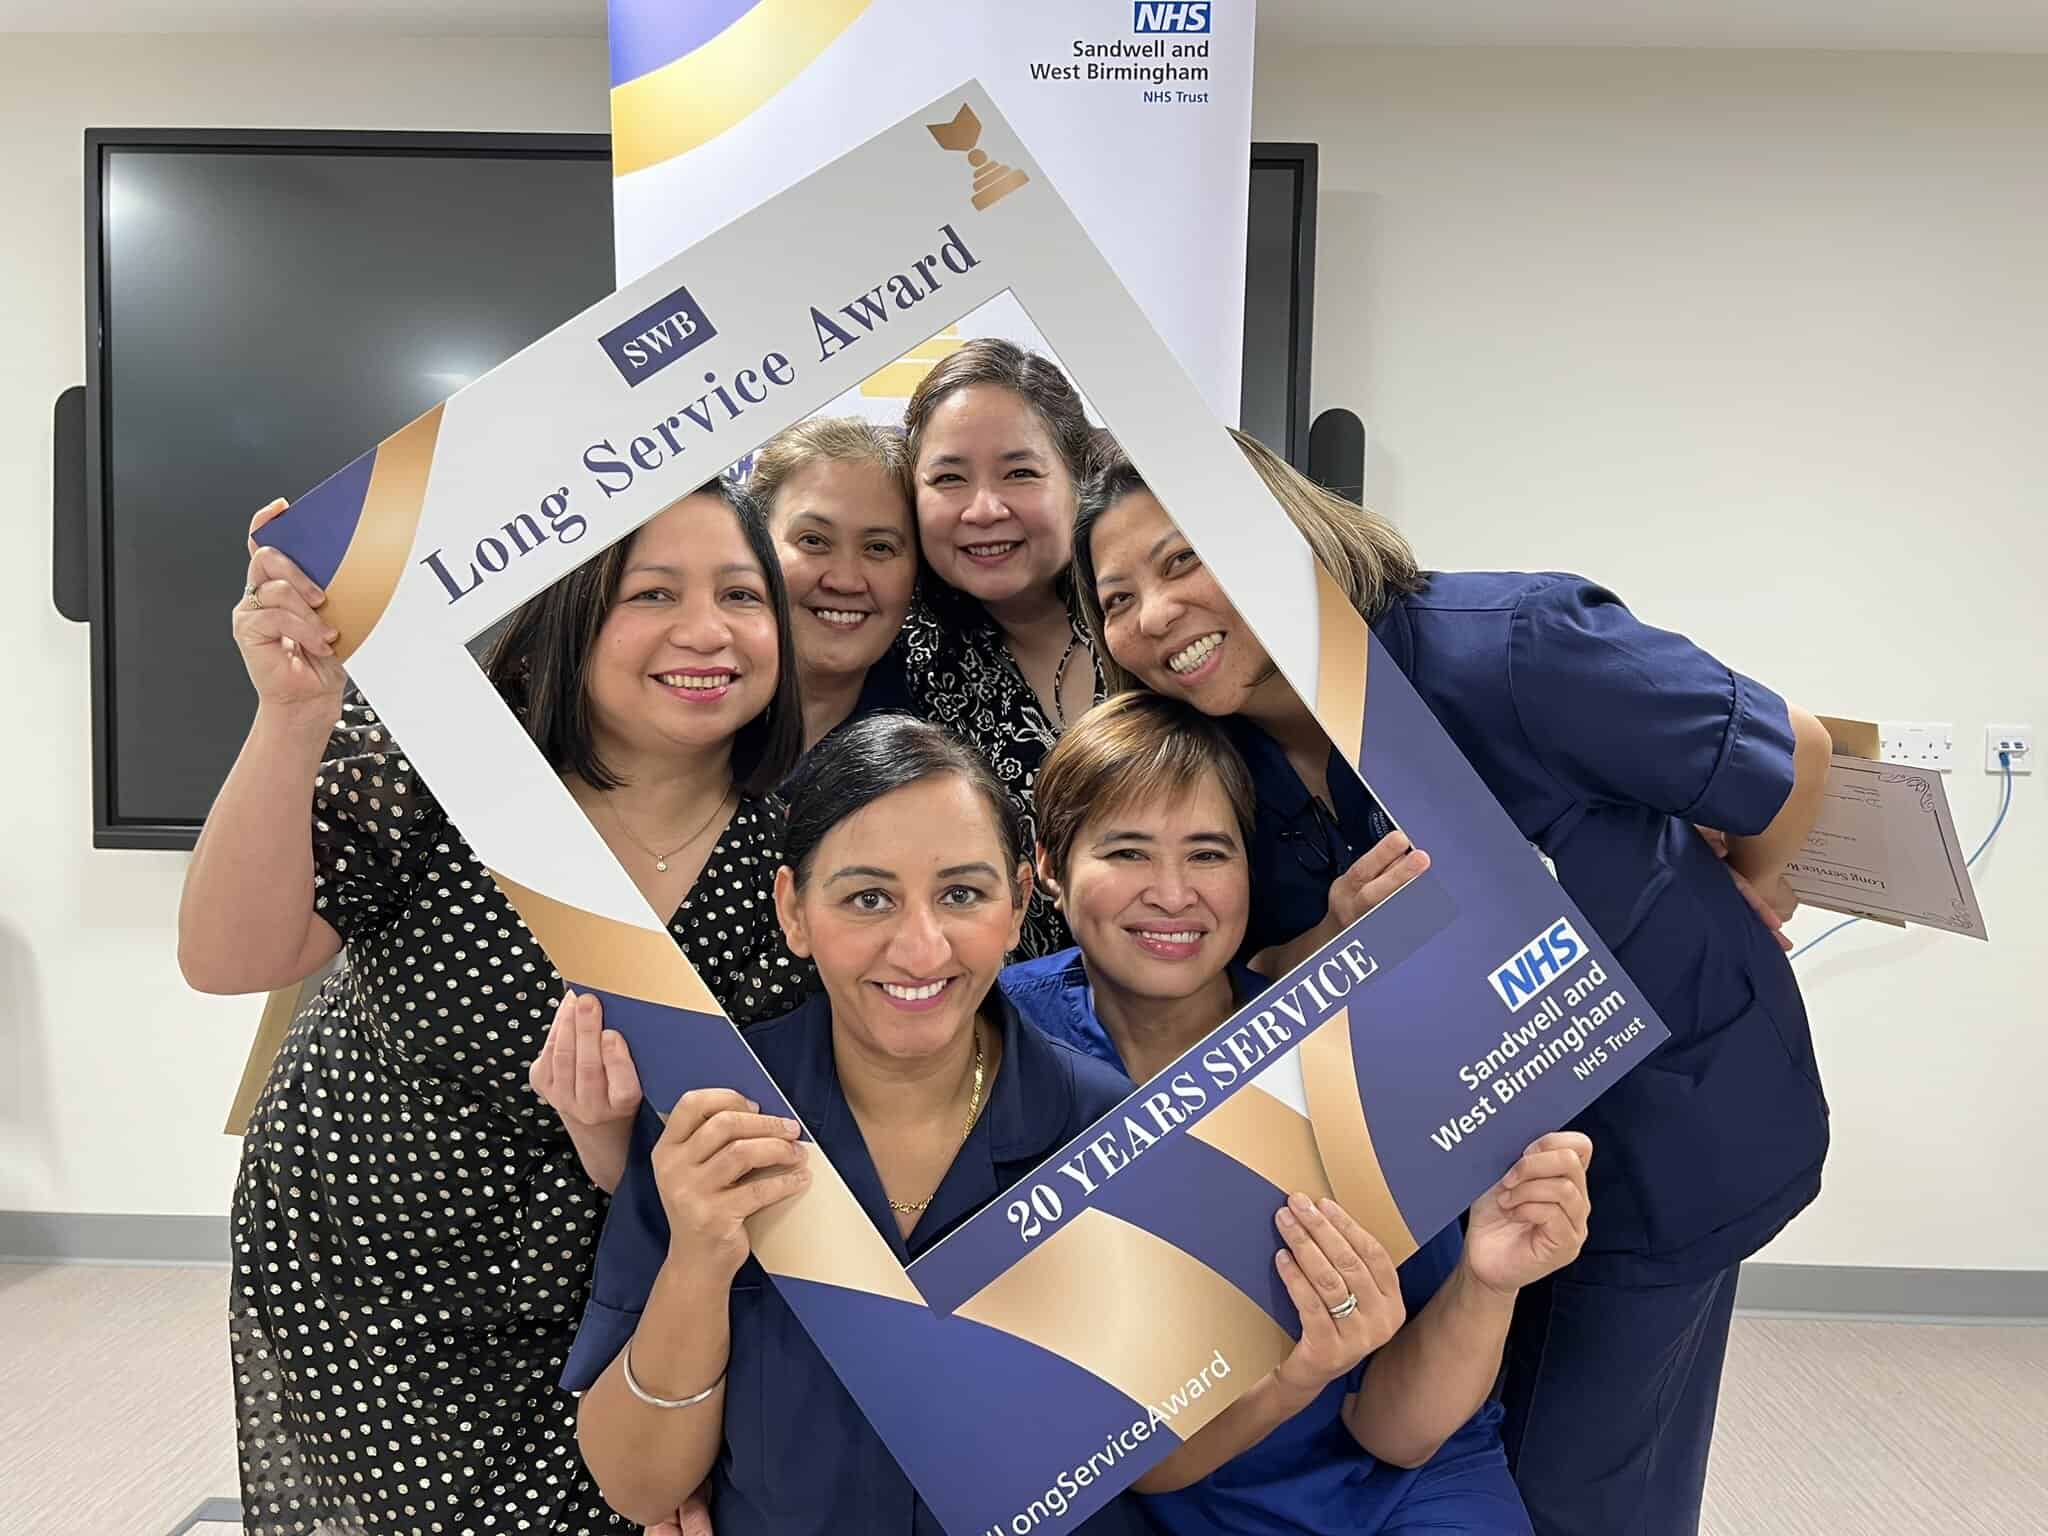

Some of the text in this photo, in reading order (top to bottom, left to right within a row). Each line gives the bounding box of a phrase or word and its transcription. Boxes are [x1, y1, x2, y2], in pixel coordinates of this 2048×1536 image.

[1073, 40, 1209, 58] Sandwell and
[1135, 3, 1208, 32] NHS
[1030, 63, 1209, 84] West Birmingham
[1143, 91, 1209, 103] NHS Trust
[621, 309, 698, 369] SWB
[420, 224, 981, 605] Long Service Award
[1497, 923, 1578, 1008] NHS
[1458, 959, 1608, 1091] Sandwell and
[1572, 1016, 1646, 1081] NHS Trust
[1006, 938, 1380, 1243] 20 YEARS SERVICE
[1430, 990, 1627, 1152] West Birmingham
[985, 1349, 1232, 1536] ongServiceAward
